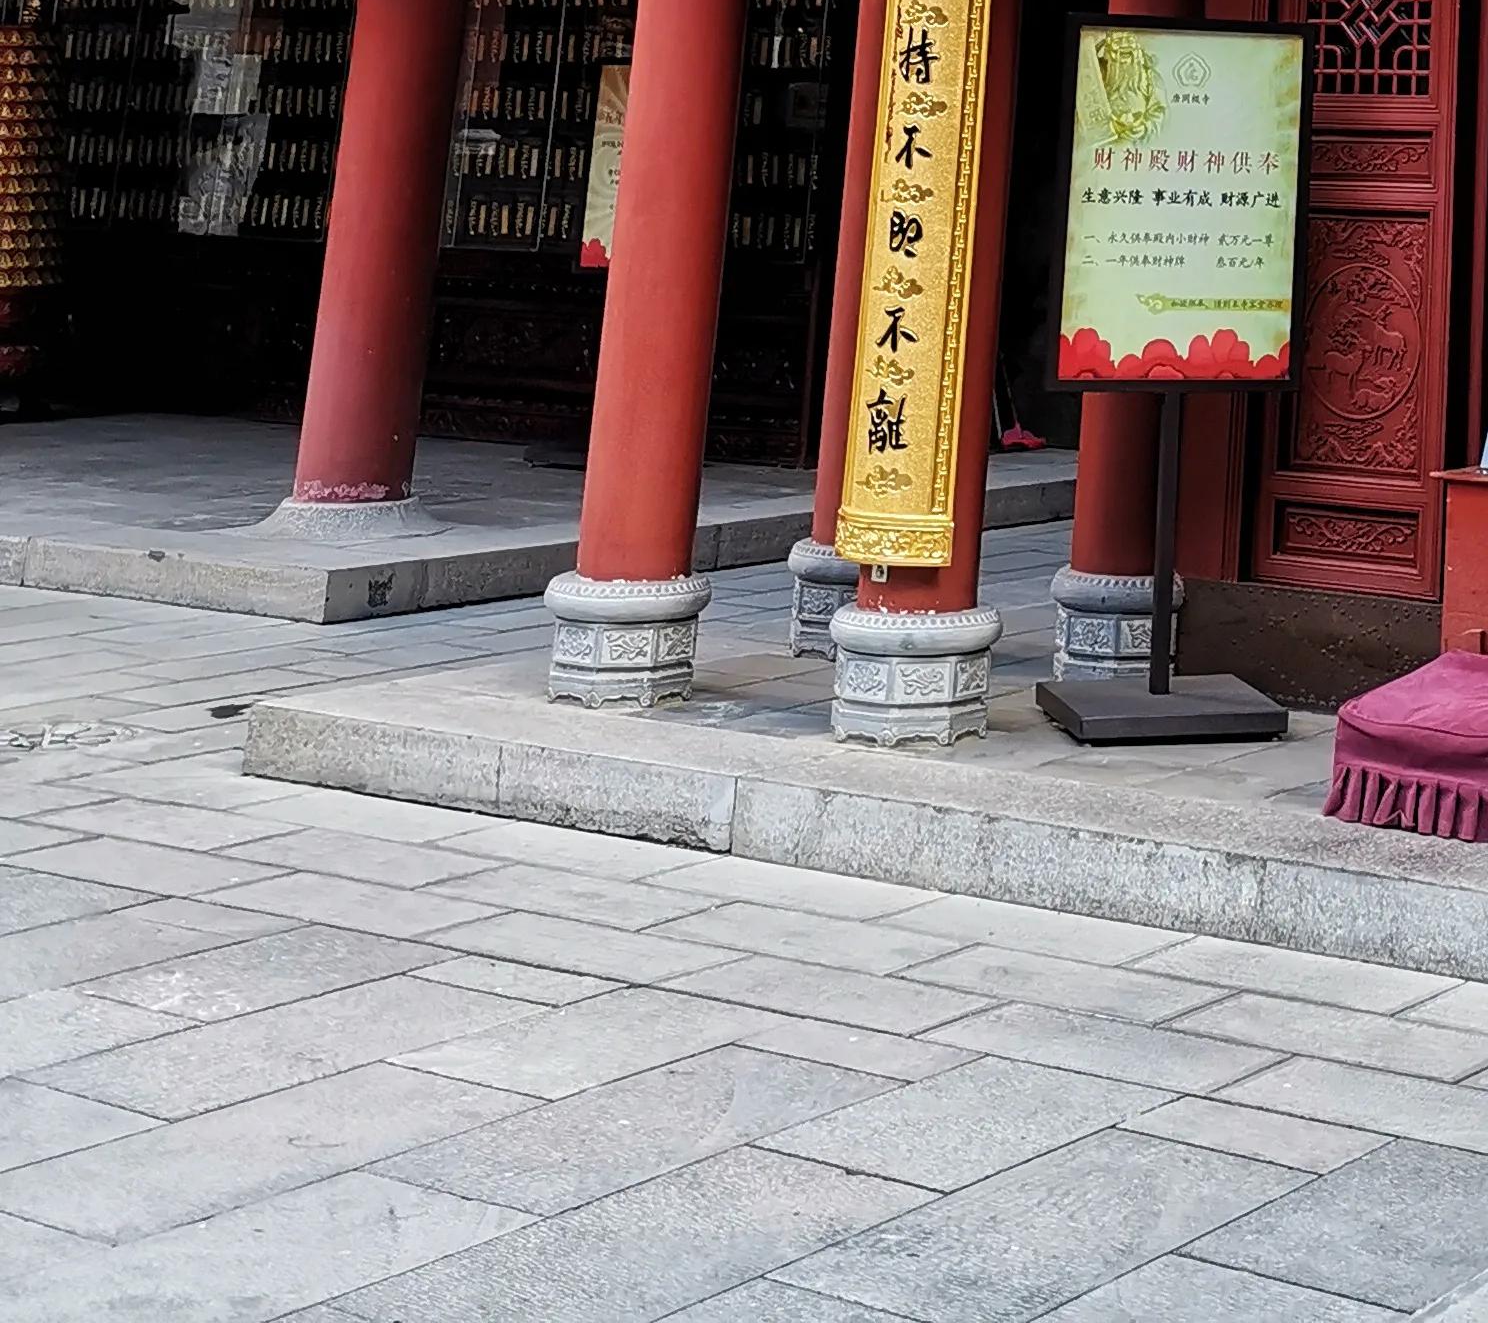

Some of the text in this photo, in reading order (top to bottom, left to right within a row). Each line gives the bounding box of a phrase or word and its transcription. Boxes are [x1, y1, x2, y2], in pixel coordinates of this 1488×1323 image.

[1091, 147, 1281, 176] 财神殿财神供奉
[1080, 186, 1282, 209] 生意兴隆 事业有成 财源广进
